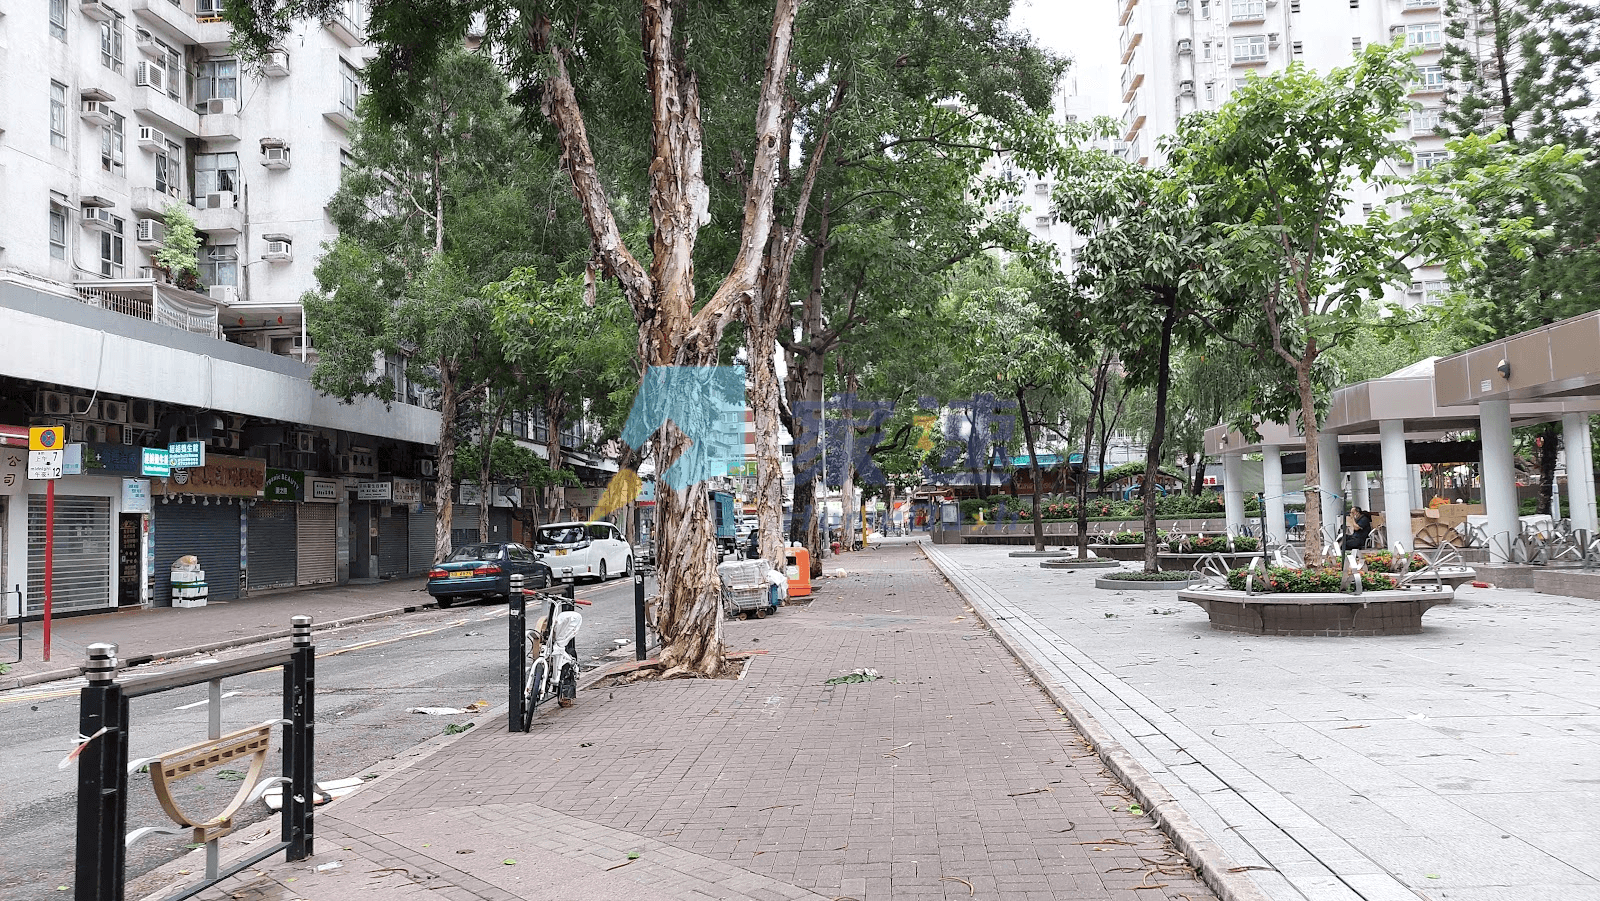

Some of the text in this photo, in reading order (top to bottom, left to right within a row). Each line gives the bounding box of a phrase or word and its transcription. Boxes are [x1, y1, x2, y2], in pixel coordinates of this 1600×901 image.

[52, 451, 58, 461] 7
[4, 455, 22, 487] 公司
[52, 467, 61, 477] 12
